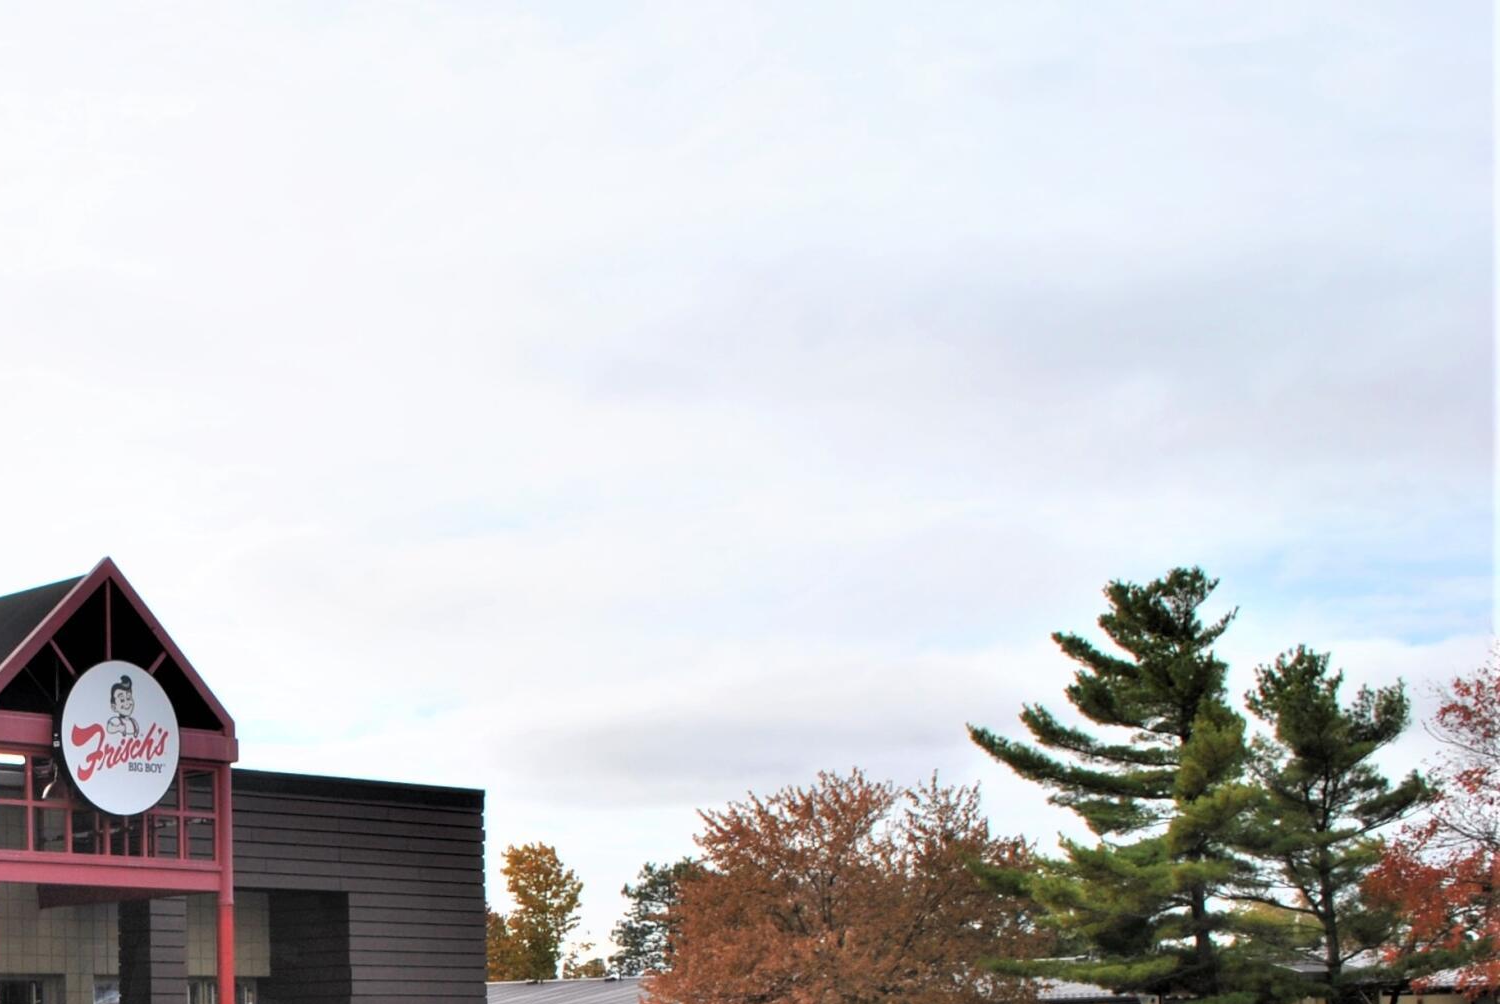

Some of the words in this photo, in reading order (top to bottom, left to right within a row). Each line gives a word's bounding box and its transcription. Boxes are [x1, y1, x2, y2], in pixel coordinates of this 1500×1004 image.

[71, 722, 169, 781] Frisch's
[128, 762, 143, 773] BIG
[145, 763, 162, 773] BOY
